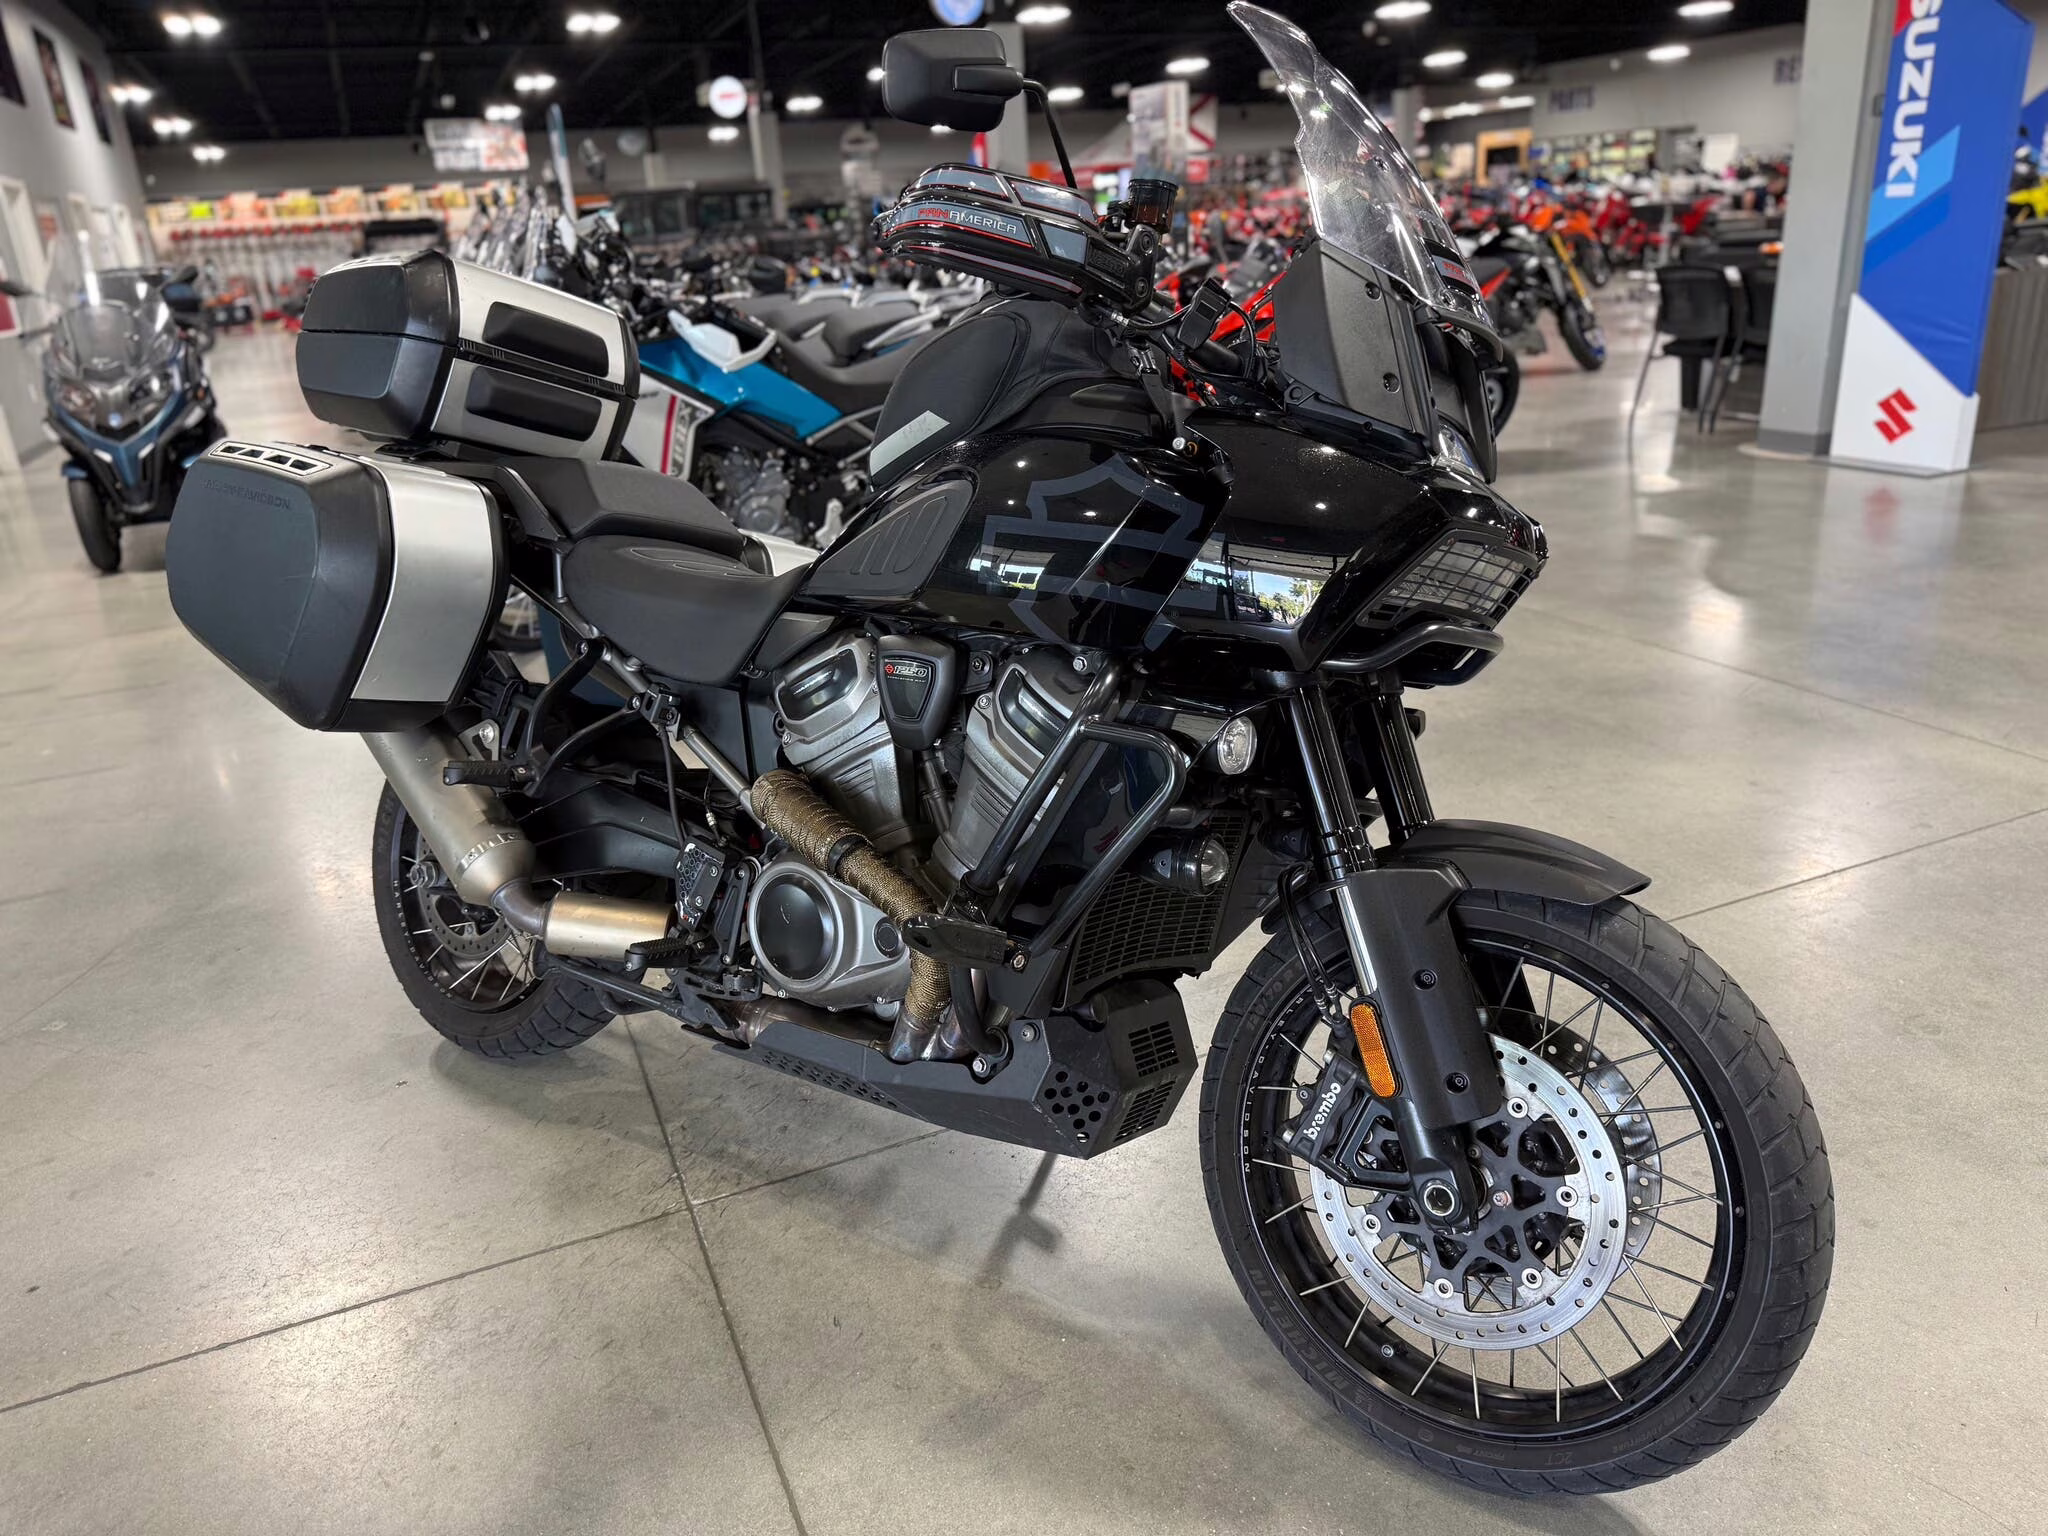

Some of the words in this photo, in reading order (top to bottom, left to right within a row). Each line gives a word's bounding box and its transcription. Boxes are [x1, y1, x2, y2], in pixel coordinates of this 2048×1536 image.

[949, 209, 1017, 235] AMERICA
[892, 665, 928, 677] 1250
[1303, 1082, 1342, 1141] brembo
[1249, 1269, 1350, 1390] MICHELIN
